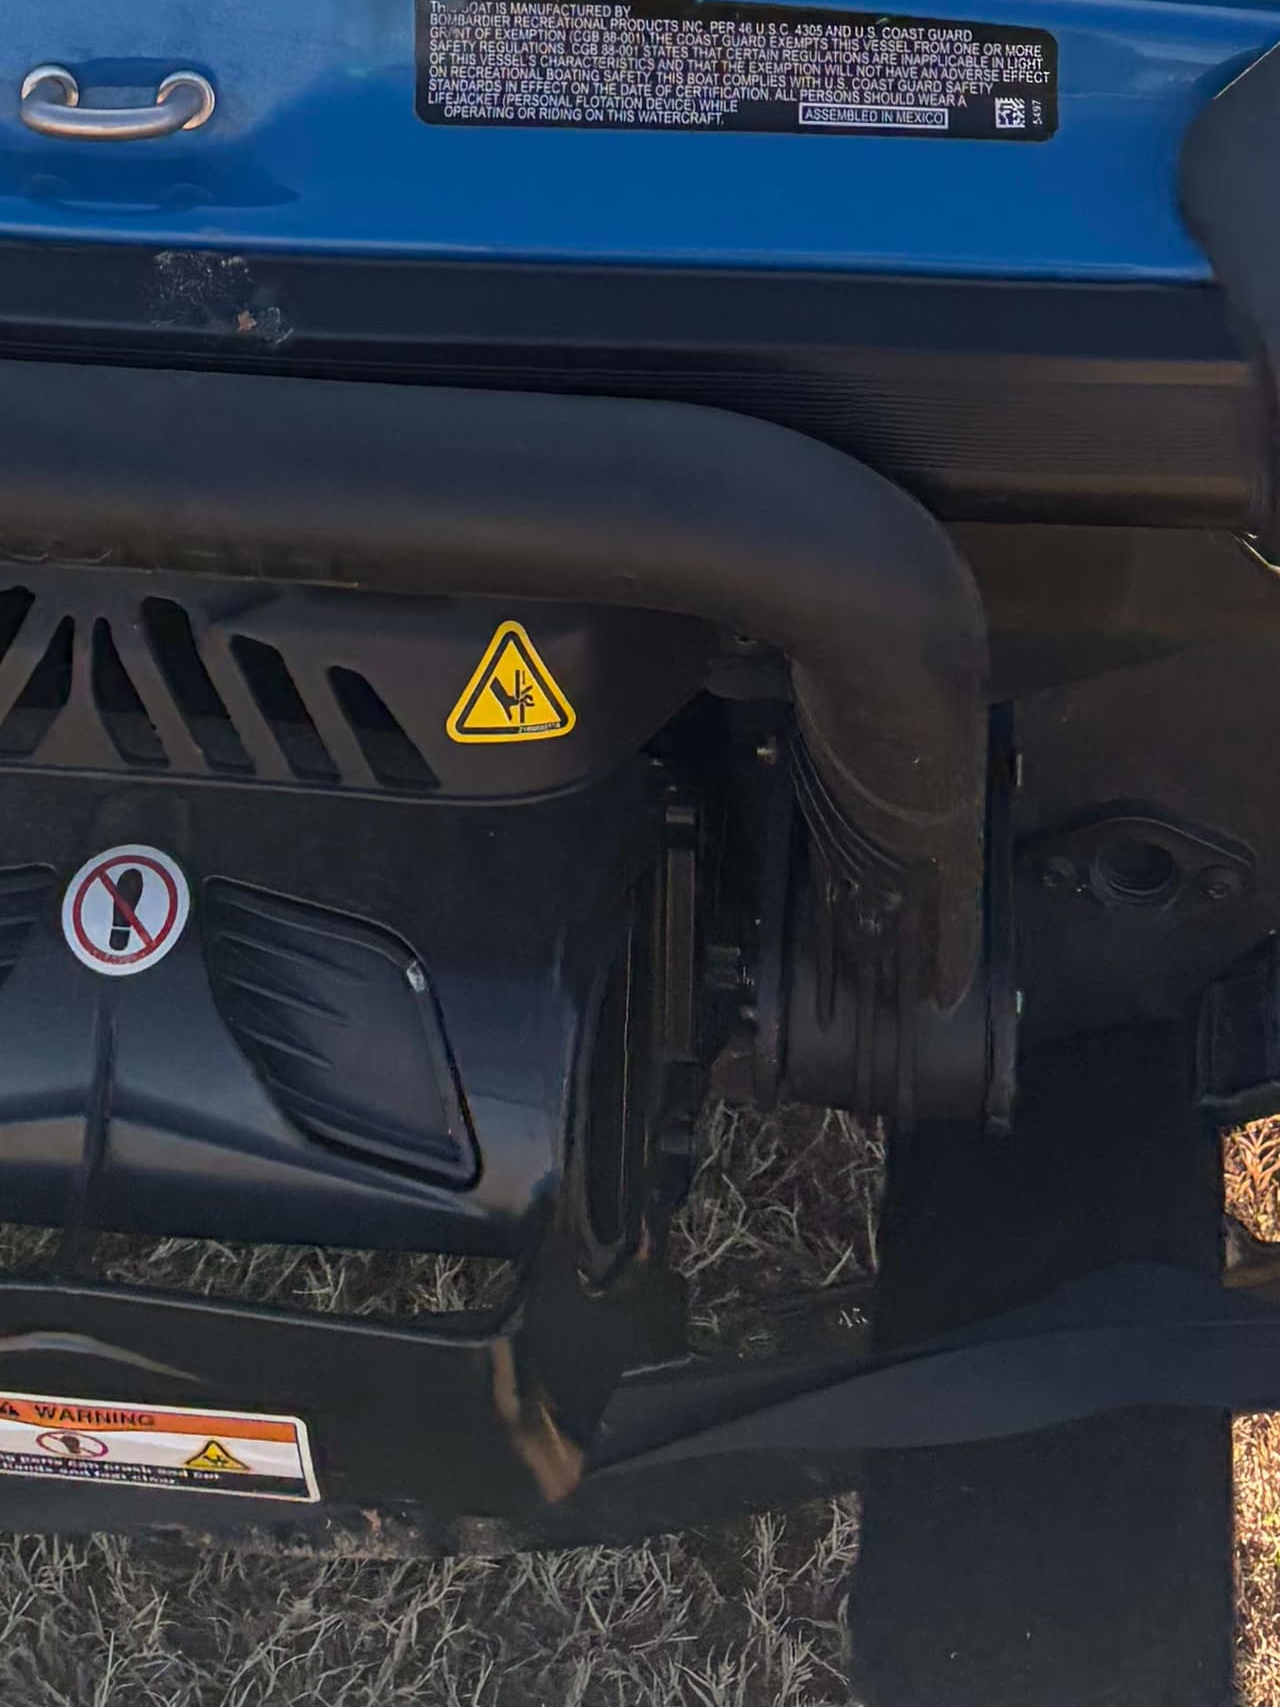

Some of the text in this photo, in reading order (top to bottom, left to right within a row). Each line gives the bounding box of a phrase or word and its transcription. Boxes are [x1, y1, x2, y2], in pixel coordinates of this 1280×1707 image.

[461, 1, 492, 14] OAT
[496, 1, 507, 15] IS
[510, 2, 611, 17] MANUFACTURED
[614, 4, 631, 18] BY
[429, 12, 972, 42] BOMBARDIER RECREATIONAL PRODUCTS PER 4305 AND COAST GUARD
[474, 27, 1042, 57] OF EXEMPTION (CGB THE COAST GUARD EXEMPTS THIS VESSEL FROM ONE OR MORE
[429, 38, 1043, 71] SAFETY CGB 88-001 STATES THAT CERTAIN REGULATIONS ARE INAPPLICABLE IN LIGHT
[429, 51, 1050, 84] OF THIS VESSEL'S CHARACTERISTICS AND THAT THE EXEMPTION WILL NOT HAVE AN ADVERSE EFFECT
[428, 64, 994, 95] ON RECREATIONAL BOATING THIS BOAT COMPLIES WITH U.S. COAST GUARD SAFETY
[428, 77, 967, 107] STANDARDS IN EFFECT ON THE DATE OF CERTIFICATION. ALL PERSONS SHOULD WEAR A
[427, 90, 738, 113] LIFEJACKET (PERSONAL FLOTATION DEVICE) WHILE
[444, 104, 724, 126] OPERATING OR RIDING ON THIS WATERCRAFT.
[805, 108, 943, 124] ASSEMBLED IN MEXICO
[33, 1403, 156, 1429] WARNING
